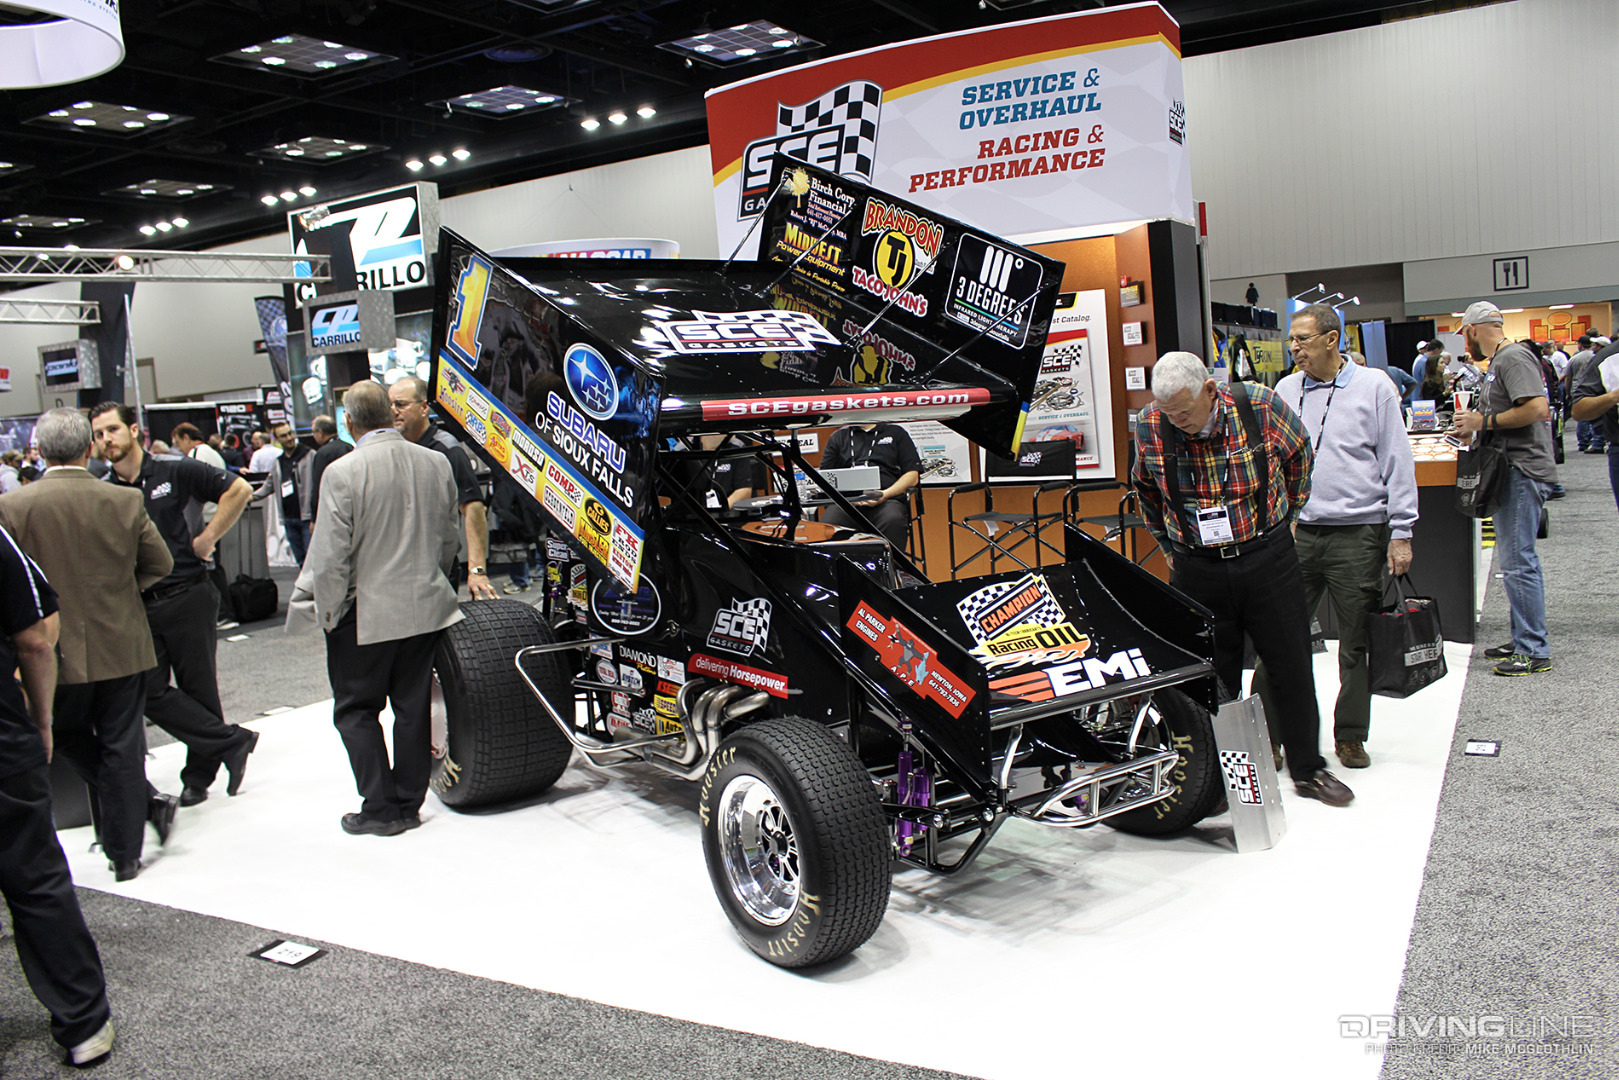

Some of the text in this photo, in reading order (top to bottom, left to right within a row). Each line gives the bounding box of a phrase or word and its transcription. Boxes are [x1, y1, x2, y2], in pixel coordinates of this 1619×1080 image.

[962, 68, 1100, 105] SERVICE &
[959, 92, 1101, 130] OVERHAUL
[977, 125, 1104, 159] RACING &
[908, 148, 1106, 193] PERFORMANCE
[811, 177, 833, 197] Birch
[809, 189, 847, 214] Financial
[863, 198, 942, 258] BRANDON
[776, 240, 802, 257] Power
[853, 266, 928, 316] TACO JOHN'S
[956, 276, 1028, 325] 3 DEGREES
[446, 253, 493, 371] 1
[312, 332, 361, 348] CARRILLO
[676, 323, 790, 341] SCE
[994, 323, 1017, 337] HERAPY
[688, 340, 799, 349] GASKETS
[1043, 355, 1072, 368] SCE
[729, 392, 969, 416] SCEgaskets.com
[547, 391, 626, 474] SUBARU
[512, 429, 545, 466] MOROSO
[535, 411, 552, 434] OF
[553, 425, 590, 471] SIOUX
[592, 458, 633, 508] FALLS
[549, 465, 575, 493] COMP
[587, 506, 609, 532] CALLIES
[611, 538, 636, 564] ENDS
[616, 524, 639, 551] FK
[618, 538, 637, 557] ROD
[858, 608, 886, 634] AL PARKER
[981, 584, 1042, 633] CHAMPION
[714, 612, 756, 641] SCE
[855, 620, 878, 642] ENGINES
[987, 636, 1038, 655] Racing
[1034, 626, 1088, 649] OIL
[619, 645, 656, 668] DIAMOND
[710, 637, 751, 652] GASKETS
[696, 657, 729, 678] delivering
[729, 665, 785, 691] Horsepower
[953, 689, 967, 702] IOWA
[699, 747, 736, 827] Hoosier
[1154, 731, 1194, 820] Hoosier
[1234, 765, 1254, 803] SCE
[768, 883, 821, 958] Hoosier
